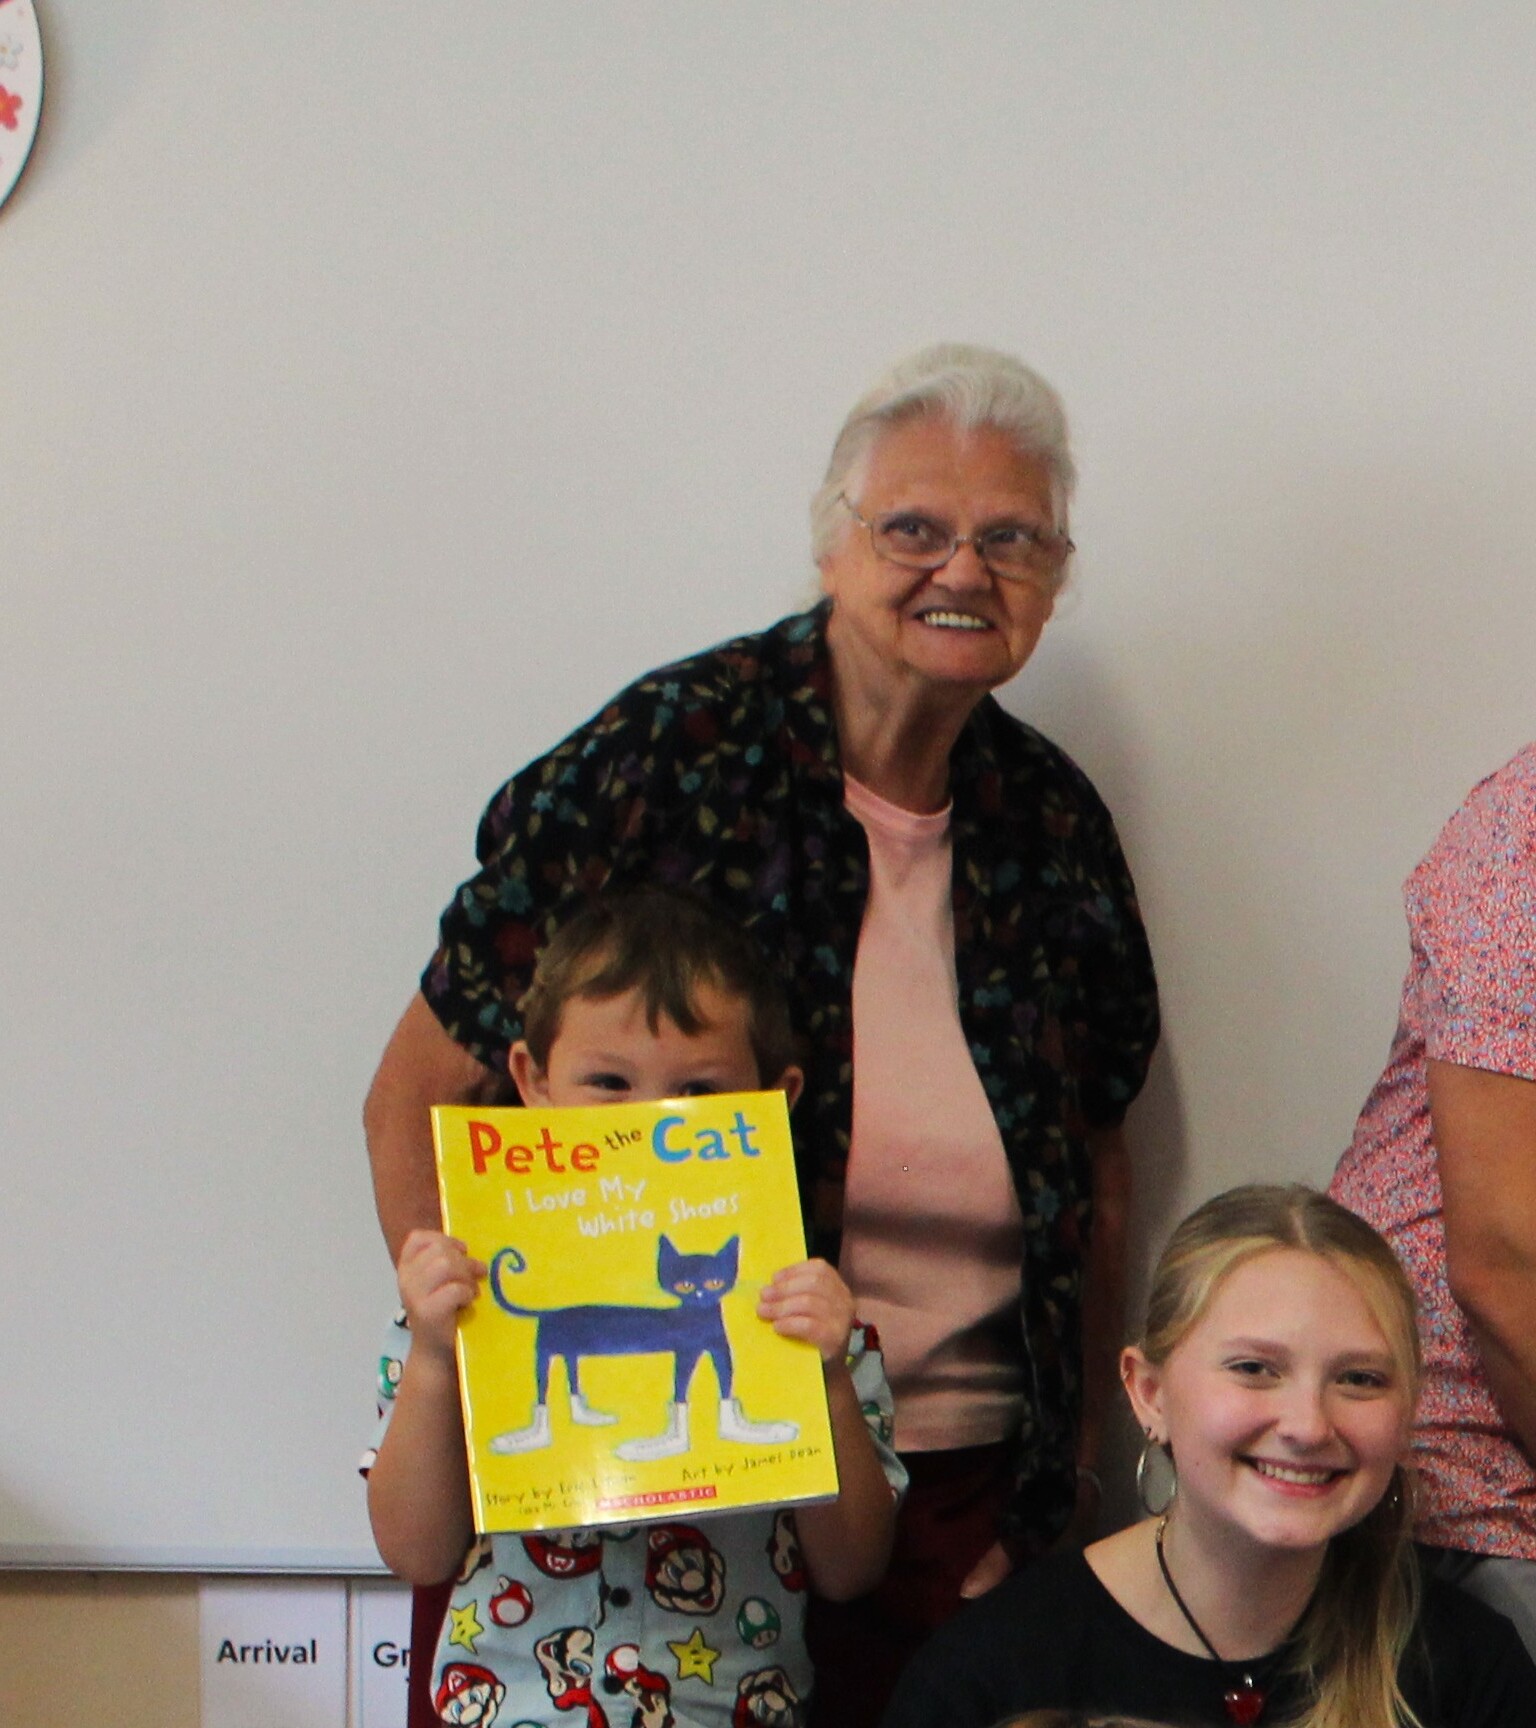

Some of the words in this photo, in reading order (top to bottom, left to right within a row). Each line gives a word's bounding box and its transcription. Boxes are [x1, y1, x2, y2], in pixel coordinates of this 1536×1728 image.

[468, 1121, 600, 1175] Pete
[606, 1127, 642, 1151] the
[652, 1112, 760, 1163] Cat
[506, 1191, 514, 1215] I
[527, 1189, 586, 1214] Love
[600, 1177, 648, 1203] My
[579, 1210, 655, 1238] White
[669, 1194, 739, 1225] Shoes
[683, 1468, 706, 1482] Art
[217, 1639, 318, 1665] Arrival
